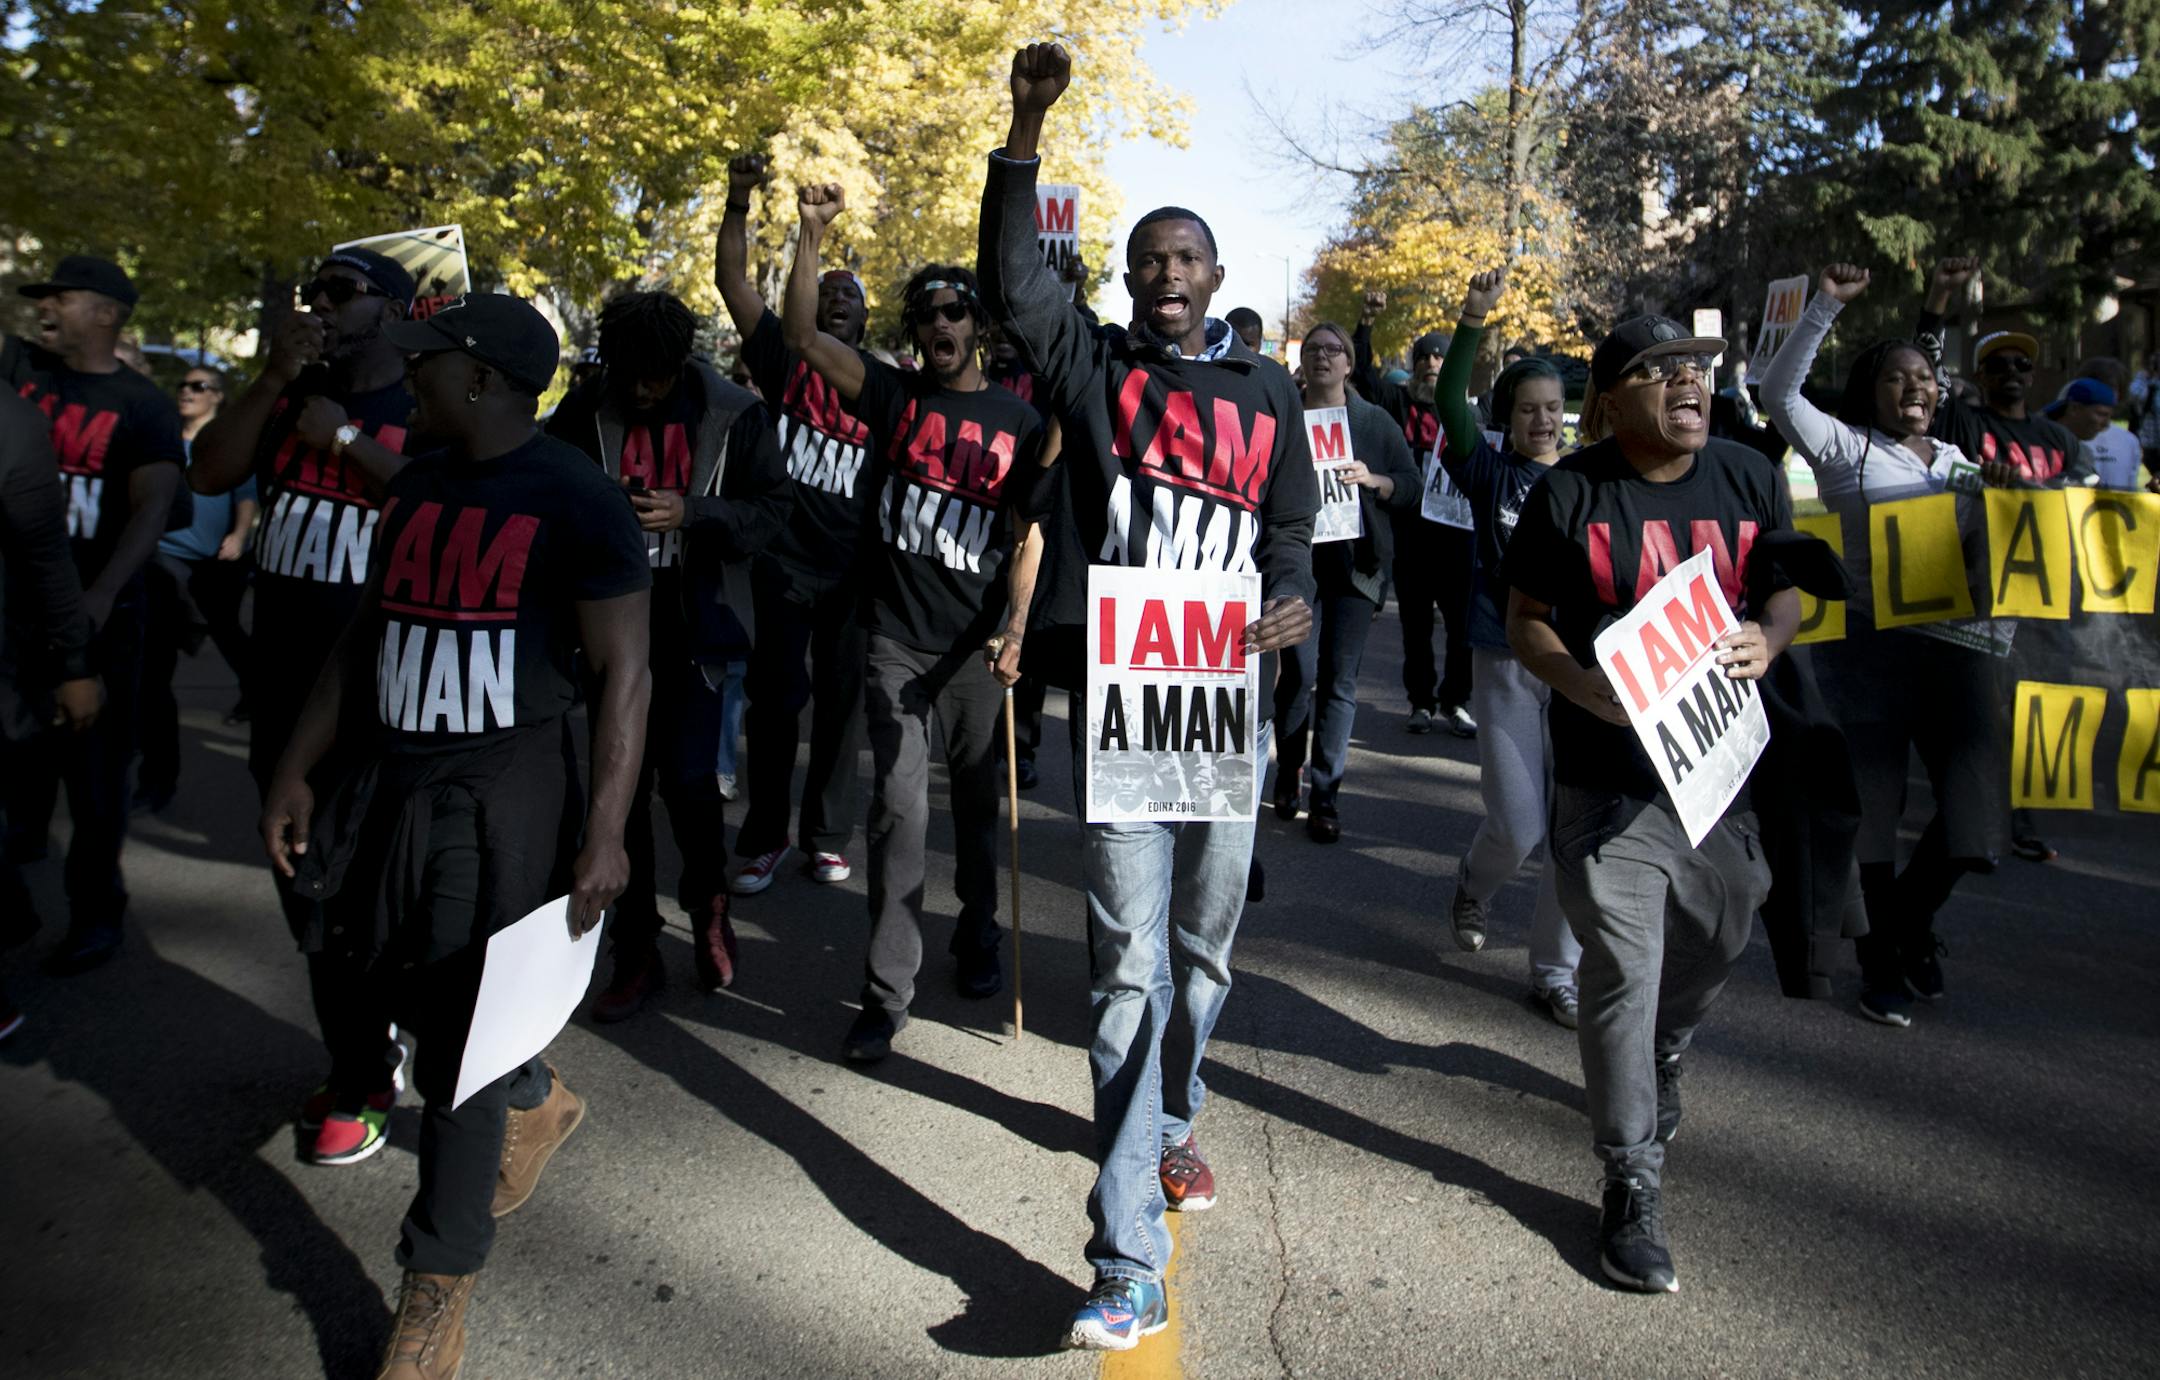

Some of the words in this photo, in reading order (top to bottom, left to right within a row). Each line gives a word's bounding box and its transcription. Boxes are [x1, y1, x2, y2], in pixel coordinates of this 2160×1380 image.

[1038, 239, 1073, 271] AN
[907, 410, 1017, 496] AM
[1111, 367, 1150, 460] I
[1141, 390, 1277, 504] AM
[261, 490, 381, 586] MAN
[383, 500, 542, 609] AM
[896, 483, 996, 574] MAN
[1100, 473, 1133, 567] A
[1587, 522, 1619, 607] I
[380, 619, 517, 734] MAN
[1100, 597, 1116, 665] I
[1130, 599, 1247, 668] AM
[1610, 649, 1650, 714] I
[1638, 573, 1729, 694] AM
[1100, 683, 1129, 751] A
[1143, 684, 1246, 754] MAN
[1656, 720, 1694, 785] A
[1148, 801, 1174, 813] EDINA
[1175, 801, 1196, 813] 2016
